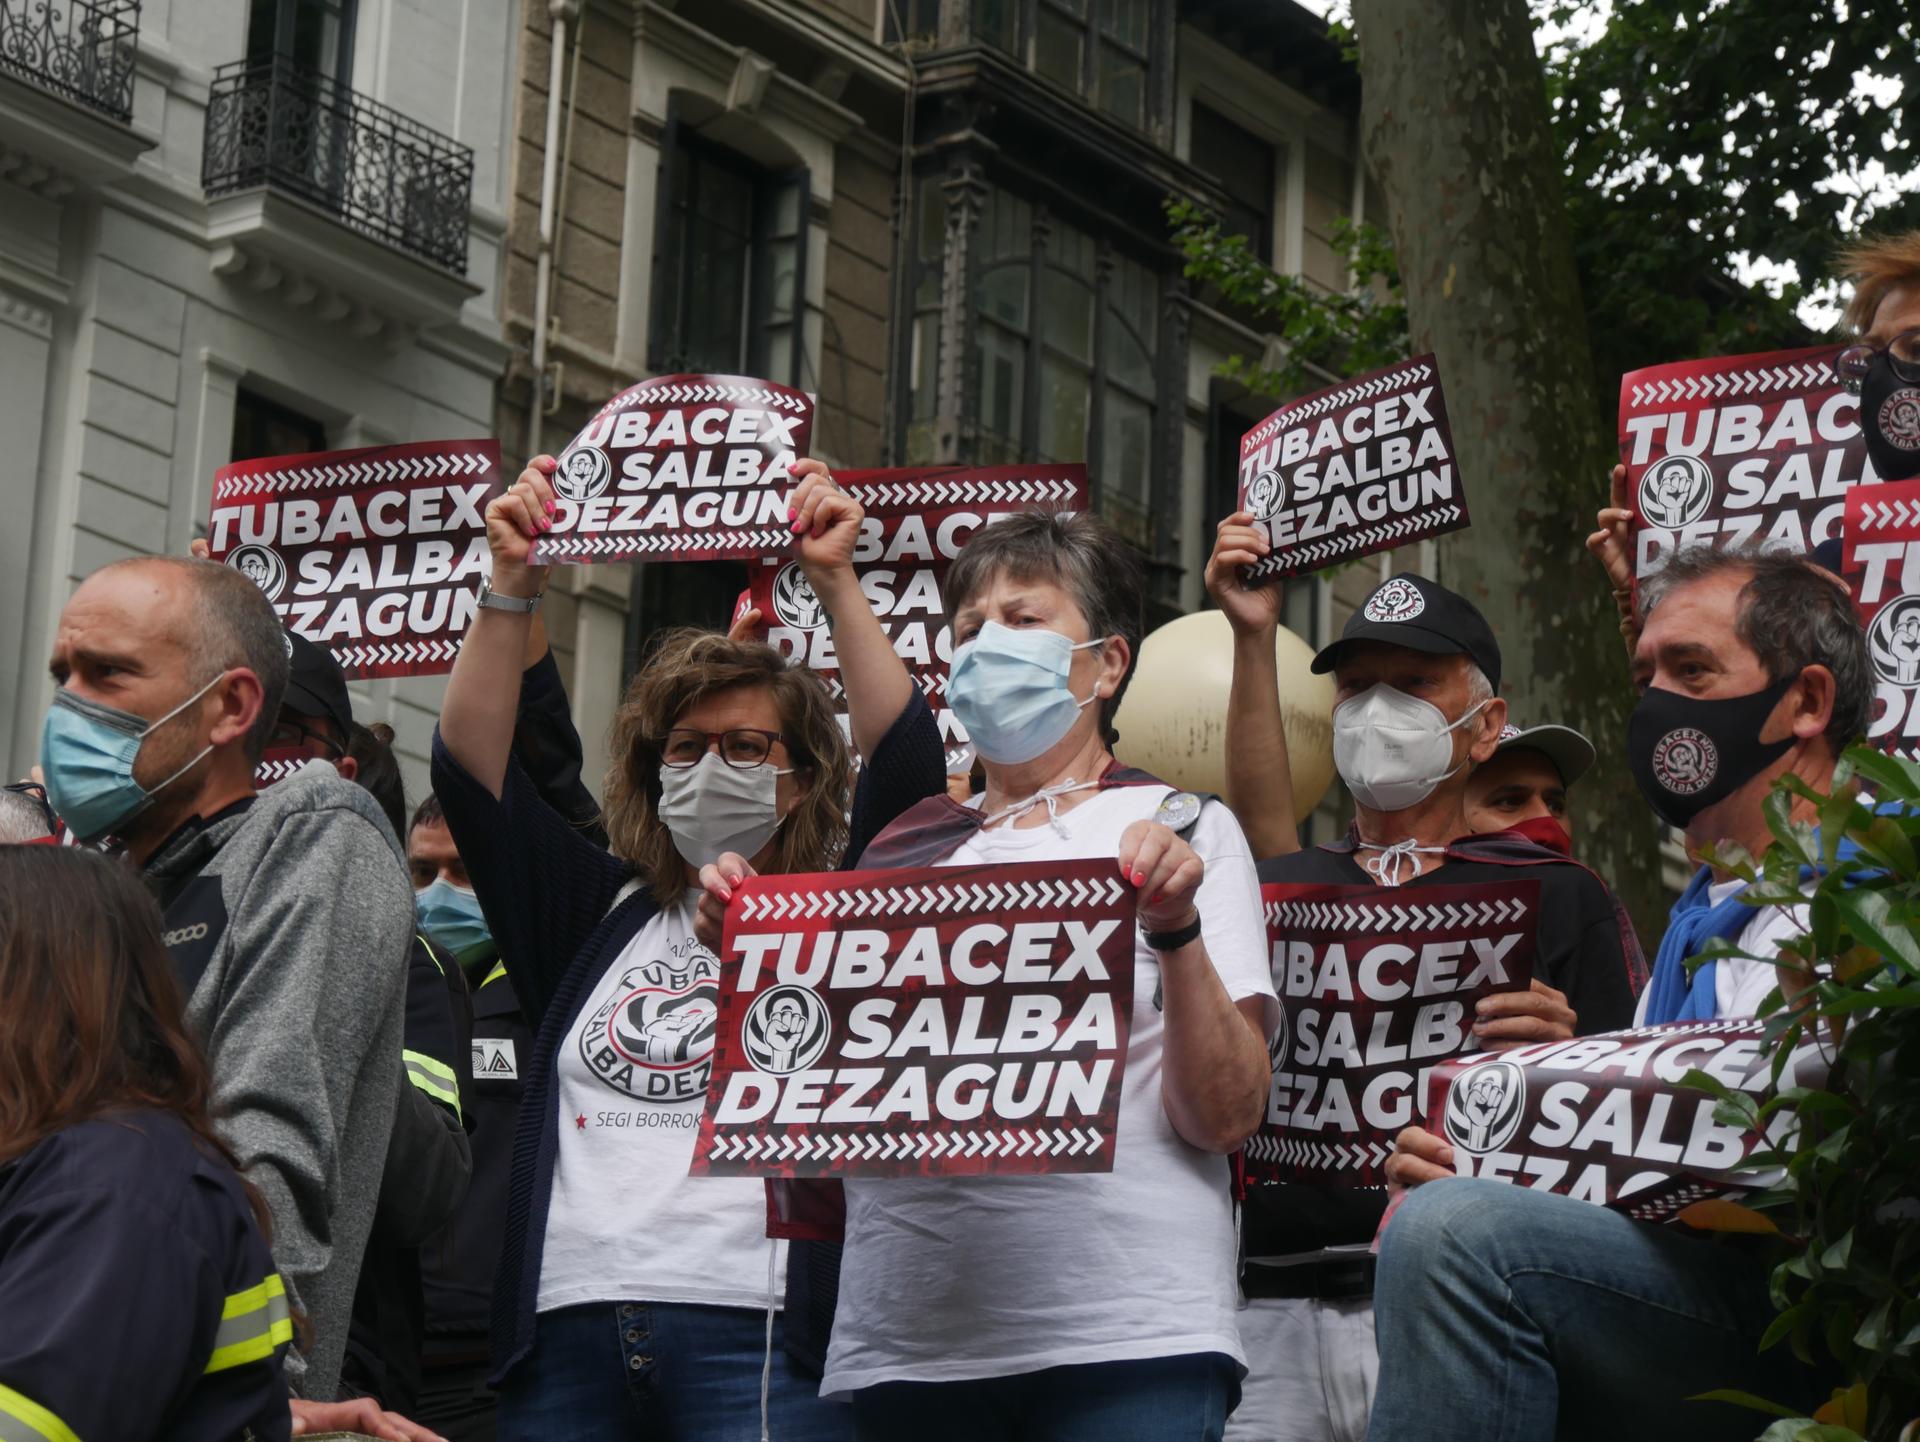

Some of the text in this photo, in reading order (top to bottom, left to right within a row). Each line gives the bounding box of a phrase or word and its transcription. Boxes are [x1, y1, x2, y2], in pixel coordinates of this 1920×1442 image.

[577, 408, 803, 449] UBACEX
[1242, 386, 1434, 488] TUBACEX
[1626, 391, 1863, 465] TUBAC
[617, 448, 797, 491] SALBA
[1293, 427, 1449, 501] SALBA
[1723, 449, 1884, 509] SAL
[210, 483, 492, 552] TUBACEX
[551, 488, 794, 534] DEZAGUN
[1248, 464, 1452, 549] EZAGUN
[293, 536, 494, 596] SALBA
[272, 586, 480, 643] ZAGUN
[1655, 730, 1699, 770] TUBACEX
[621, 961, 712, 991] TUBA
[732, 919, 1122, 992] TUBACEX
[585, 1001, 635, 1090] SALBA
[839, 992, 1118, 1060] SALBA
[1294, 1000, 1482, 1069] SALB
[596, 1111, 703, 1129] SEGI BORROK
[713, 1059, 1118, 1125] DEZAGUN
[1267, 1066, 1432, 1133] EZAG
